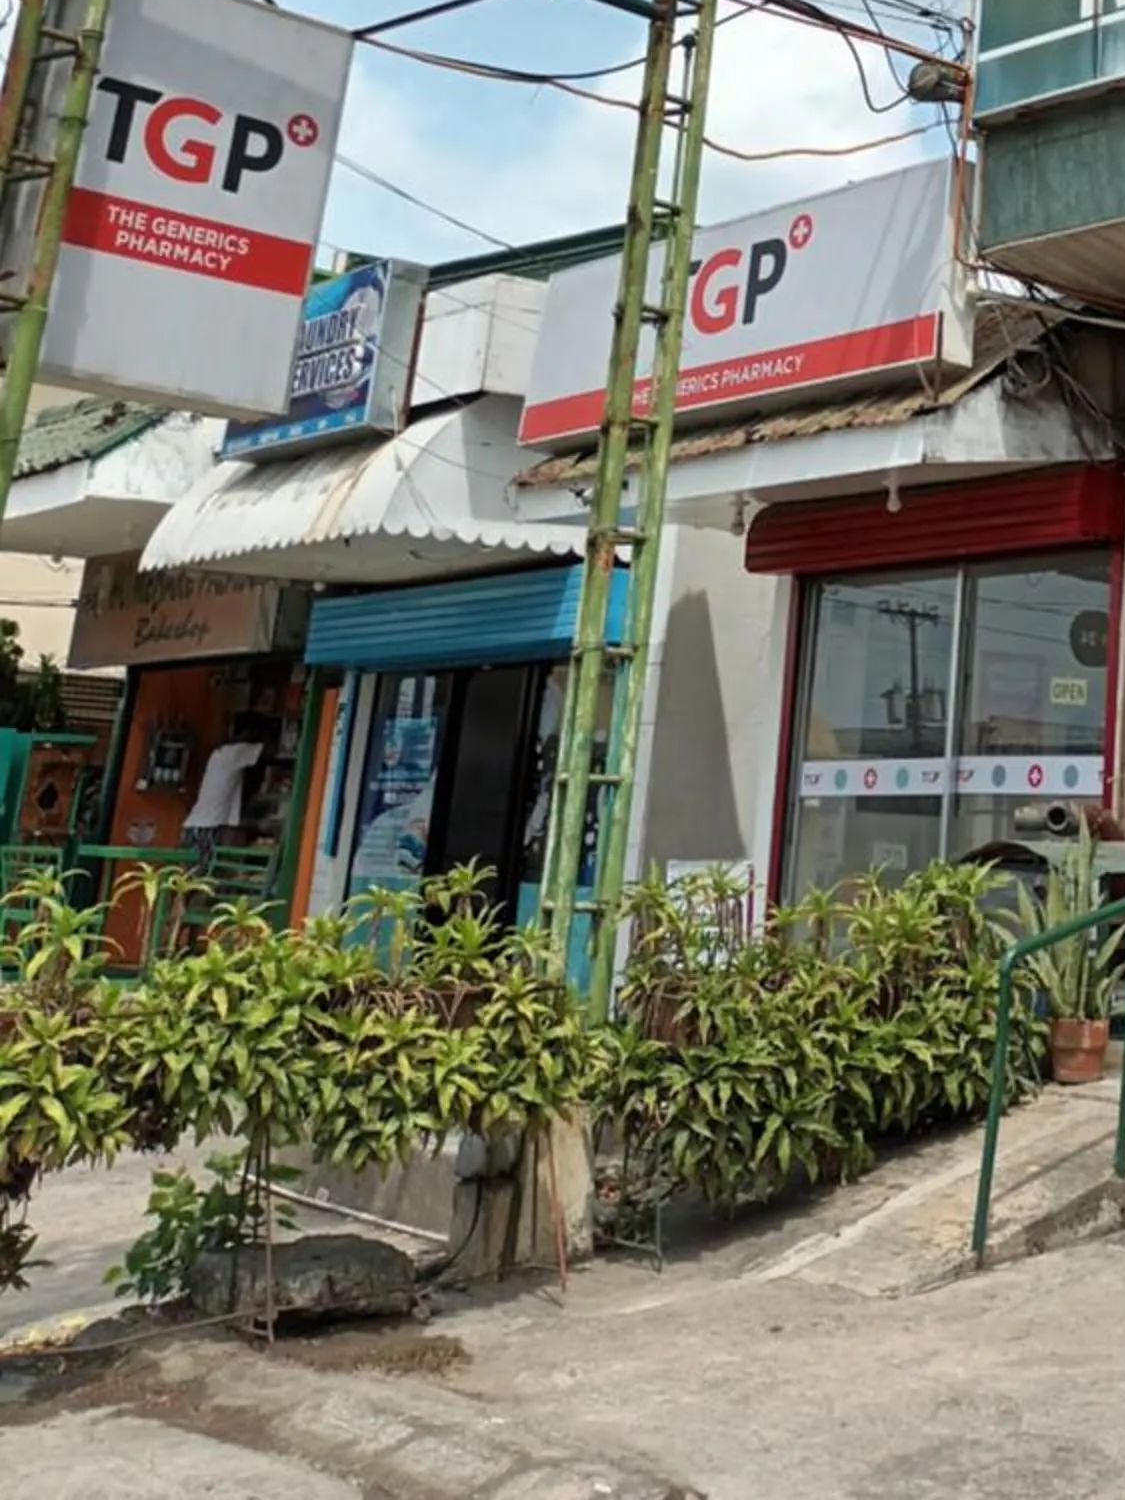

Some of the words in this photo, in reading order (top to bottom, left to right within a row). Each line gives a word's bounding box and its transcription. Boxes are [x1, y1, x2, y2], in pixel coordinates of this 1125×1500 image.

[97, 77, 284, 193] TGP
[107, 204, 147, 231] THE
[151, 216, 251, 256] GENERICS
[116, 229, 233, 273] PHARMACY
[689, 237, 788, 335] GP
[303, 307, 362, 351] UNDRY
[293, 350, 357, 395] ERVICES
[677, 371, 719, 398] ERICS
[720, 353, 804, 389] PHARMACY
